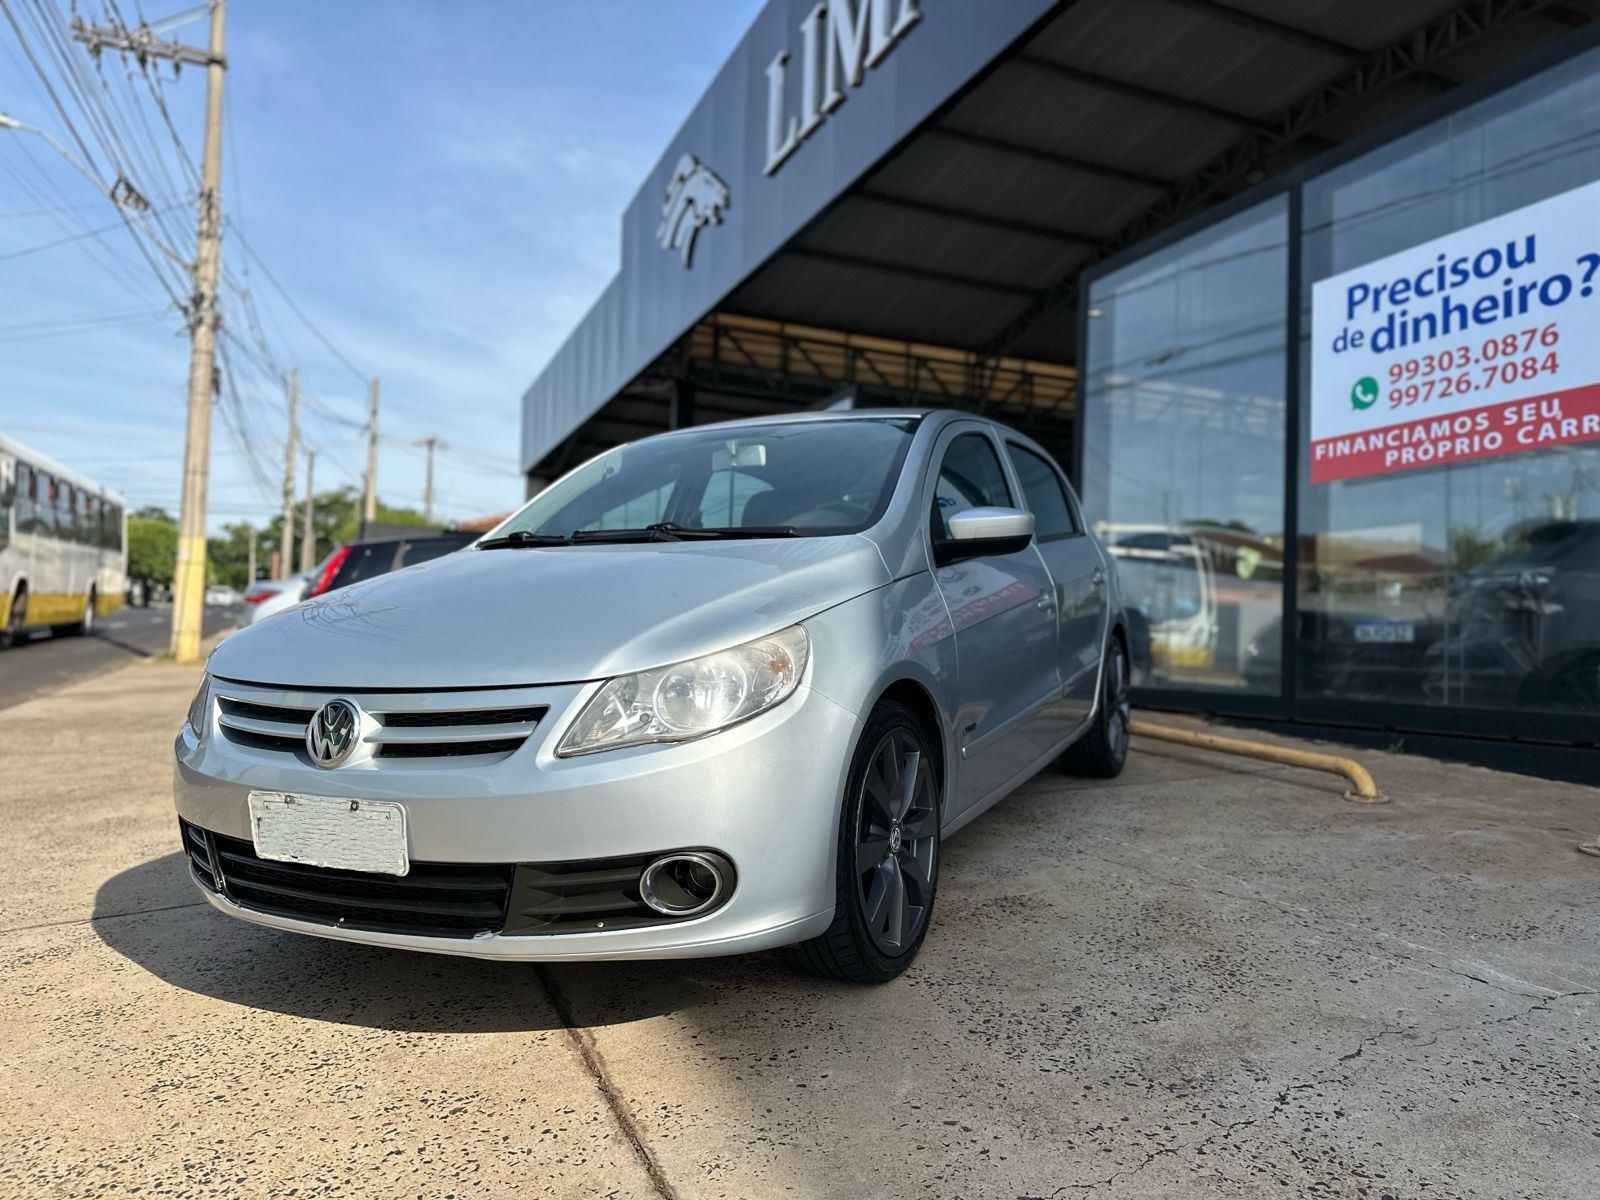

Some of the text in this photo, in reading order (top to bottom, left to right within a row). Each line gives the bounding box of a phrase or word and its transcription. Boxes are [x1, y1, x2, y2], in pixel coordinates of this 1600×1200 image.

[763, 0, 922, 175] LIM
[1332, 252, 1600, 353] de dinheiro?
[1347, 234, 1536, 321] Precisou
[1388, 322, 1560, 384] 99303.0876
[1388, 352, 1560, 409] 99726.7084
[1315, 398, 1560, 460] FINANCIAMOS SEU
[1385, 431, 1503, 467] PRÓPRIO
[309, 701, 355, 763] VW
